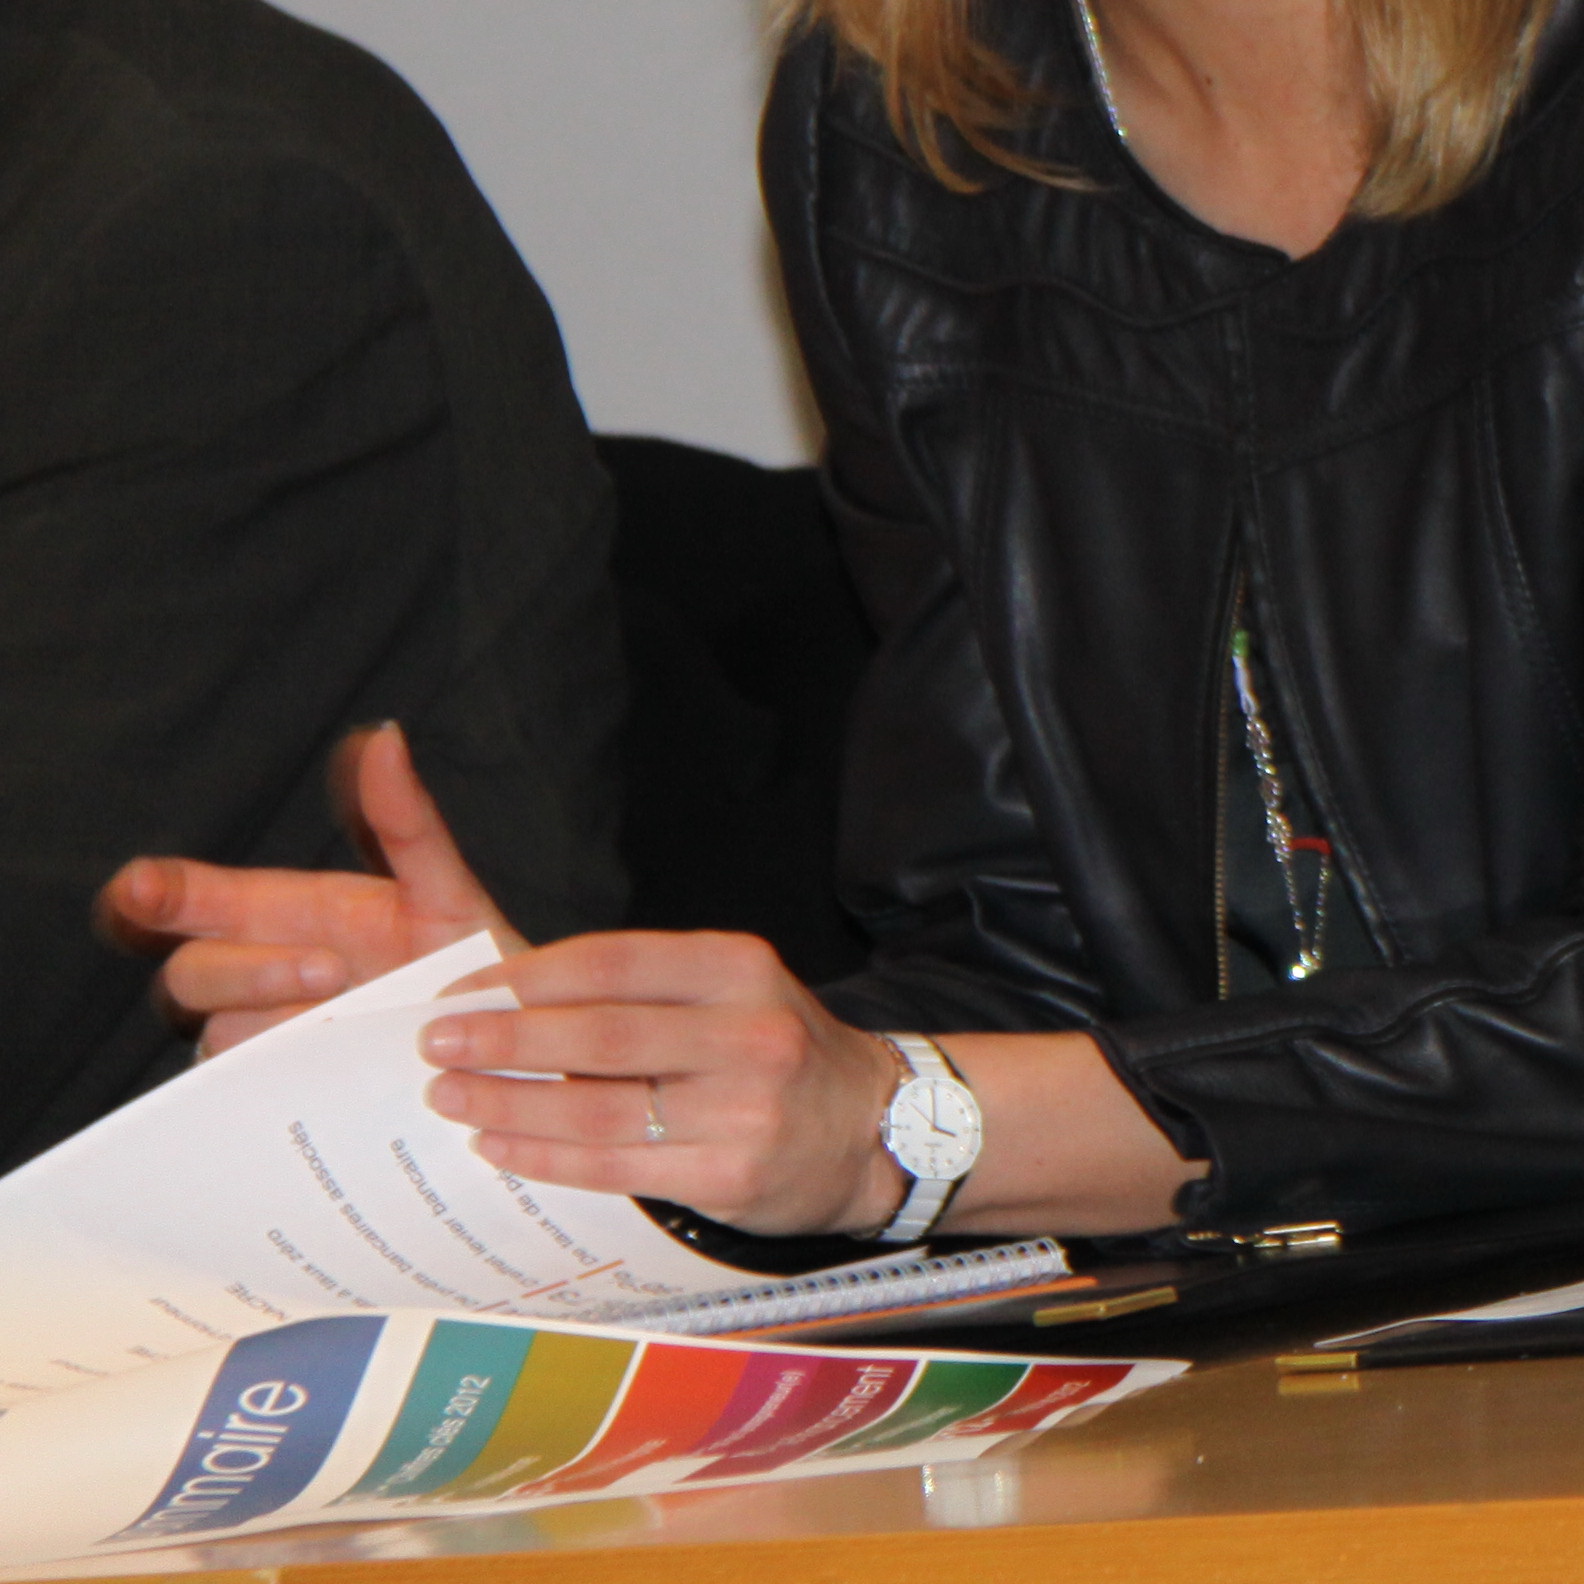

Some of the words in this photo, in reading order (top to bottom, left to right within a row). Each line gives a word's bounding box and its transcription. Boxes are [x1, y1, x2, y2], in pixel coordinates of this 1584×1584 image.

[288, 1119, 345, 1202] associés
[390, 1137, 448, 1218] bancaire
[516, 1193, 542, 1218] de
[266, 1228, 305, 1262] zéro
[340, 1202, 414, 1274] bancaires
[443, 1216, 487, 1256] levier
[535, 1216, 576, 1250] taux
[444, 1373, 493, 1418] 2012
